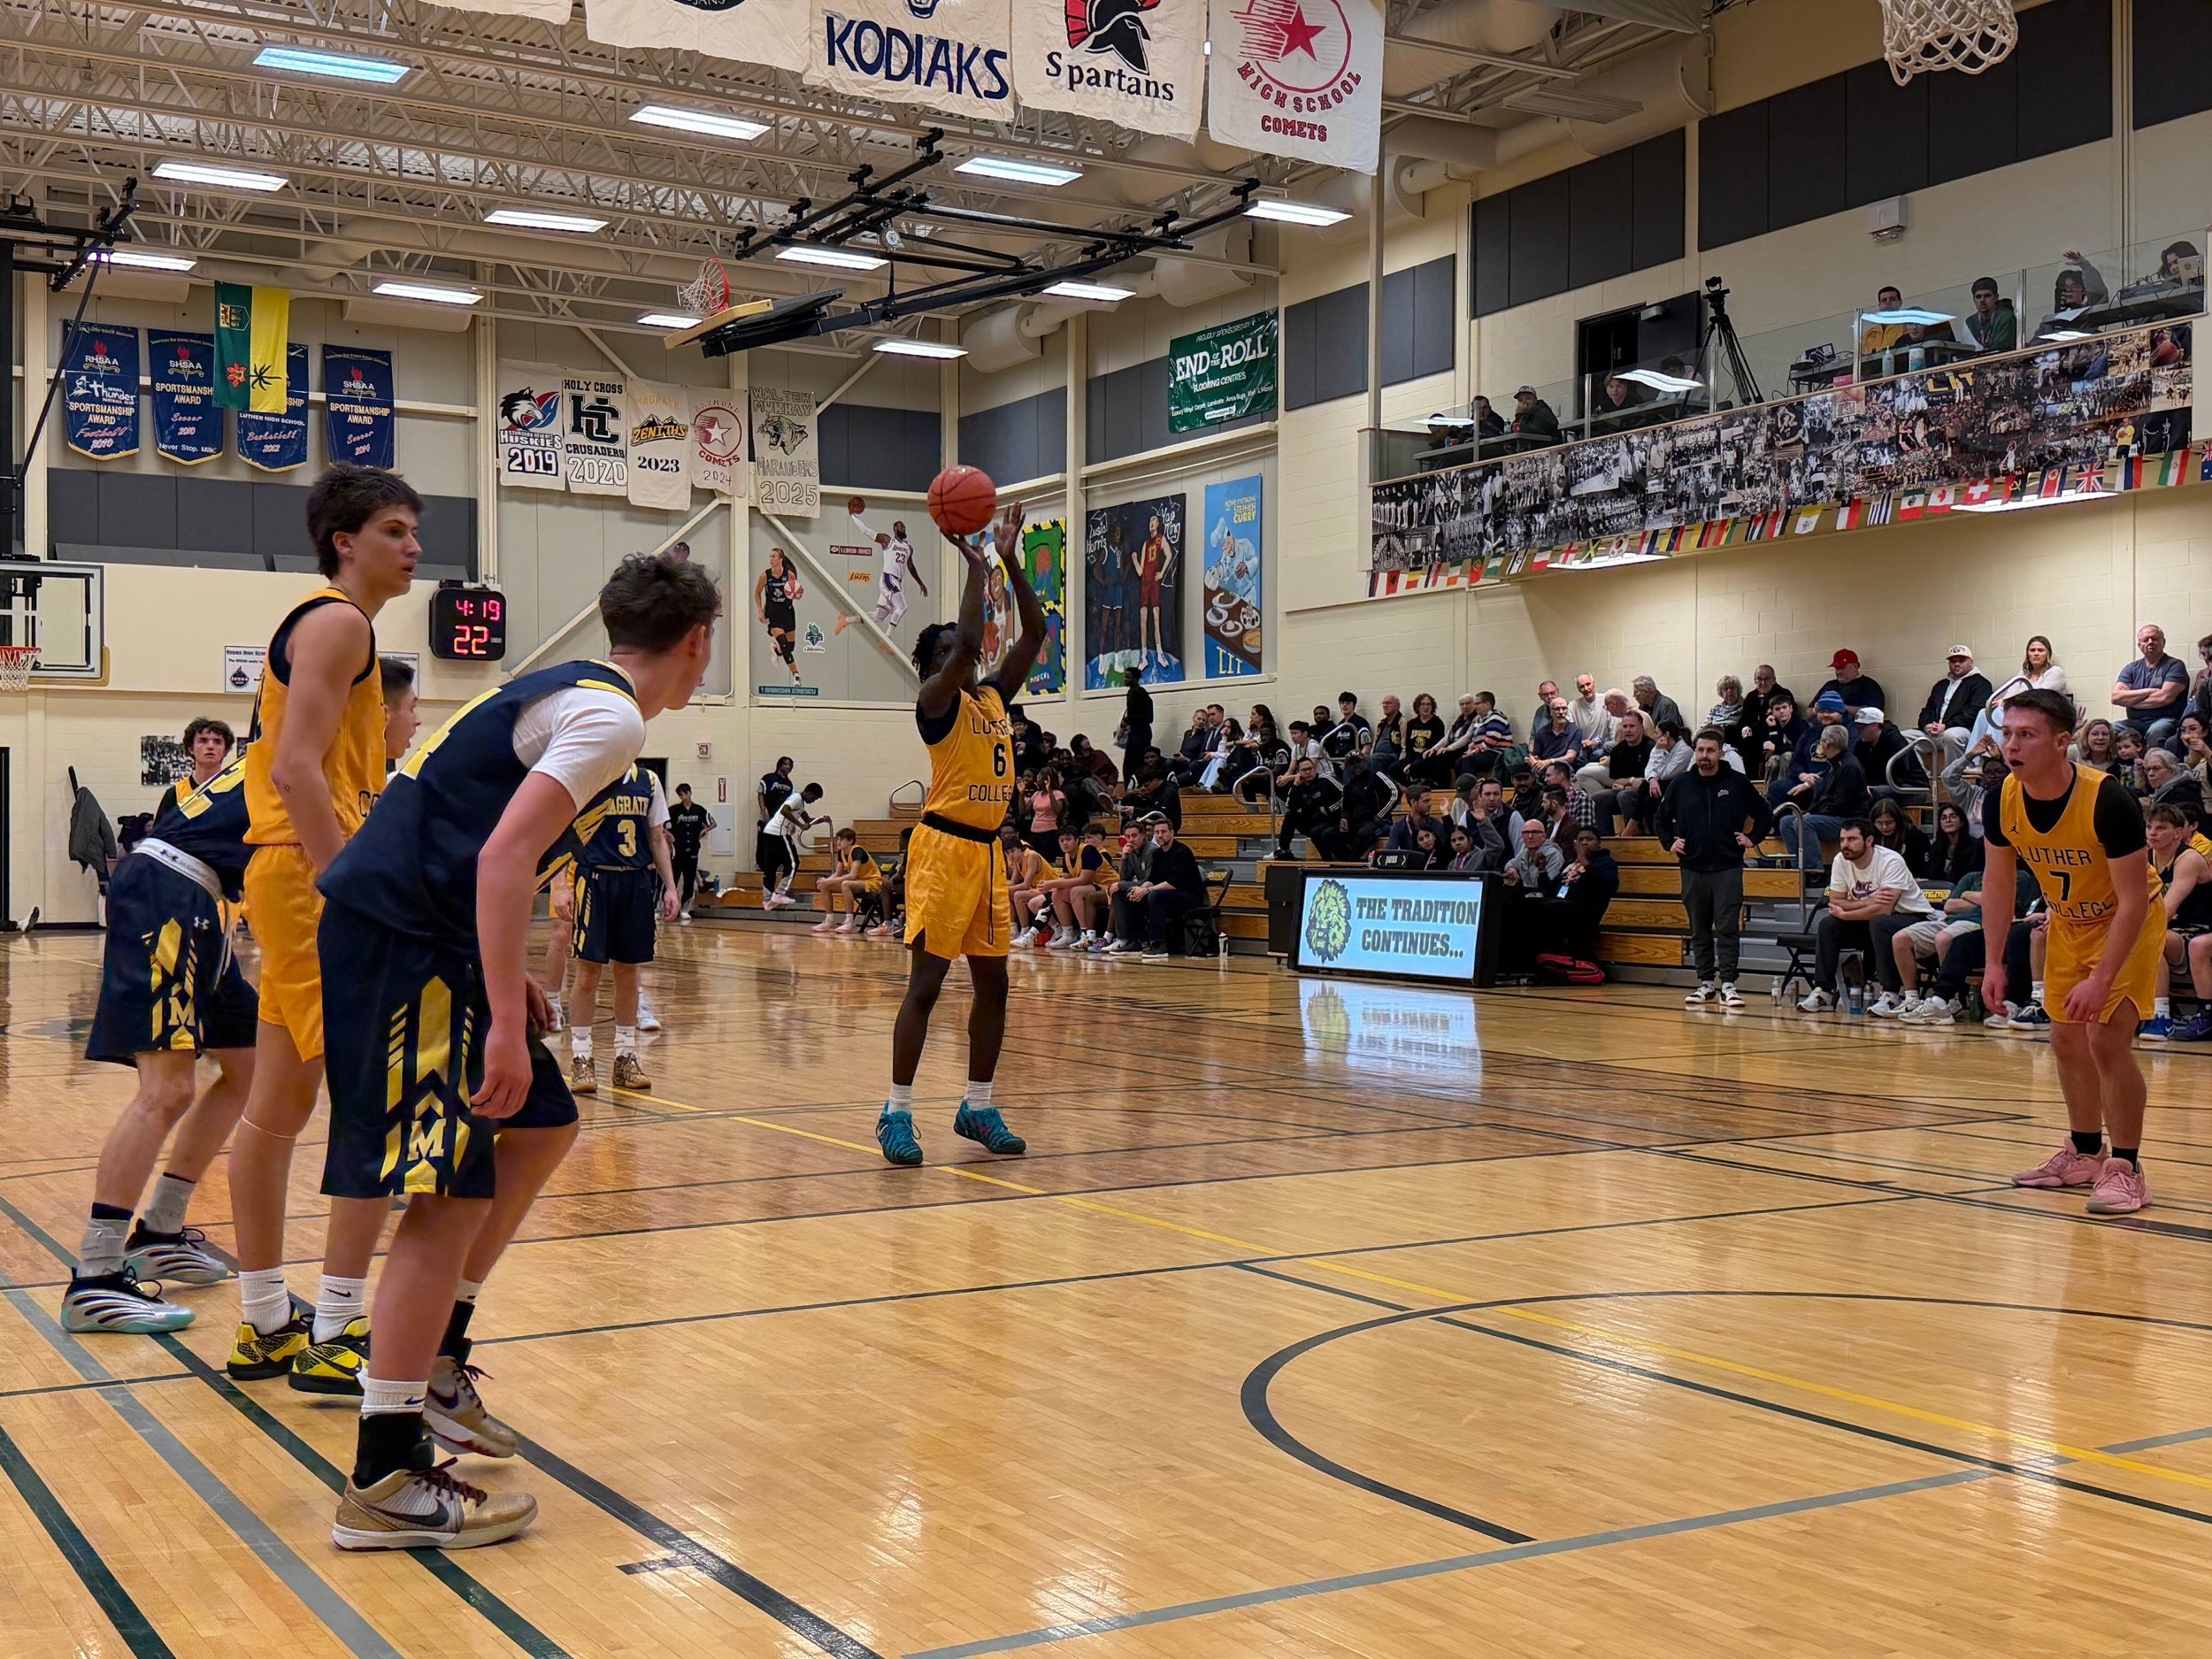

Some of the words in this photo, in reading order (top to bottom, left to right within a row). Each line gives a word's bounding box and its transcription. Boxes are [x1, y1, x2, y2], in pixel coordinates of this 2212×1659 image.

[826, 15, 1009, 100] KODIAKS
[1047, 51, 1174, 102] Spartans
[1237, 61, 1286, 107] HIGH
[1293, 71, 1363, 112] SCHOOL
[1261, 115, 1327, 142] COMETS
[85, 355, 119, 366] RHSAA
[1220, 334, 1270, 369] ROLL
[169, 360, 203, 370] SHSAA
[1176, 350, 1210, 382] END
[155, 382, 213, 396] SPORTSMANSH
[343, 380, 375, 390] SHSAA
[564, 380, 591, 391] HOLY
[594, 381, 624, 395] CROSS
[1193, 379, 1221, 394] FLOORING
[1220, 372, 1247, 385] CENTRES
[69, 402, 134, 417] SPORTSMANSHIP
[173, 395, 202, 405] AWARD
[695, 399, 741, 414] RAYMOND
[752, 399, 812, 417] MURRAY
[88, 414, 116, 425] AWARD
[170, 412, 203, 422] Soccer
[330, 403, 391, 417] SPORTSMANSHIP
[347, 414, 373, 425] AWARD
[75, 426, 128, 438] Football
[247, 430, 297, 441] Basketball
[499, 429, 563, 449] HUSKIES
[630, 423, 688, 447] ZENITHS
[566, 443, 626, 458] CRUSADERS
[699, 450, 741, 468] COMETS
[508, 447, 558, 476] 2019
[637, 456, 680, 473] 2023
[757, 457, 818, 478] MARAUDERS
[566, 457, 628, 487] 2020
[703, 470, 732, 487] 2024
[761, 480, 818, 506] 2025
[1161, 507, 1176, 524] Yao
[1089, 521, 1107, 539] Lusia
[895, 552, 906, 564] 23
[1148, 544, 1157, 563] 13
[456, 599, 501, 621] 4:19
[453, 625, 489, 655] 22
[1216, 646, 1243, 674] LIT
[993, 742, 1007, 778] 6
[609, 795, 650, 817] AGRAT
[617, 818, 636, 856] 3
[1855, 879, 1873, 891] NIKE
[2048, 870, 2071, 902] 7
[1356, 896, 1388, 920] THE
[1391, 898, 1479, 926] TRADITION
[1361, 929, 1464, 959] CONTINUES...
[168, 996, 196, 1026] M
[406, 1118, 447, 1162] M
